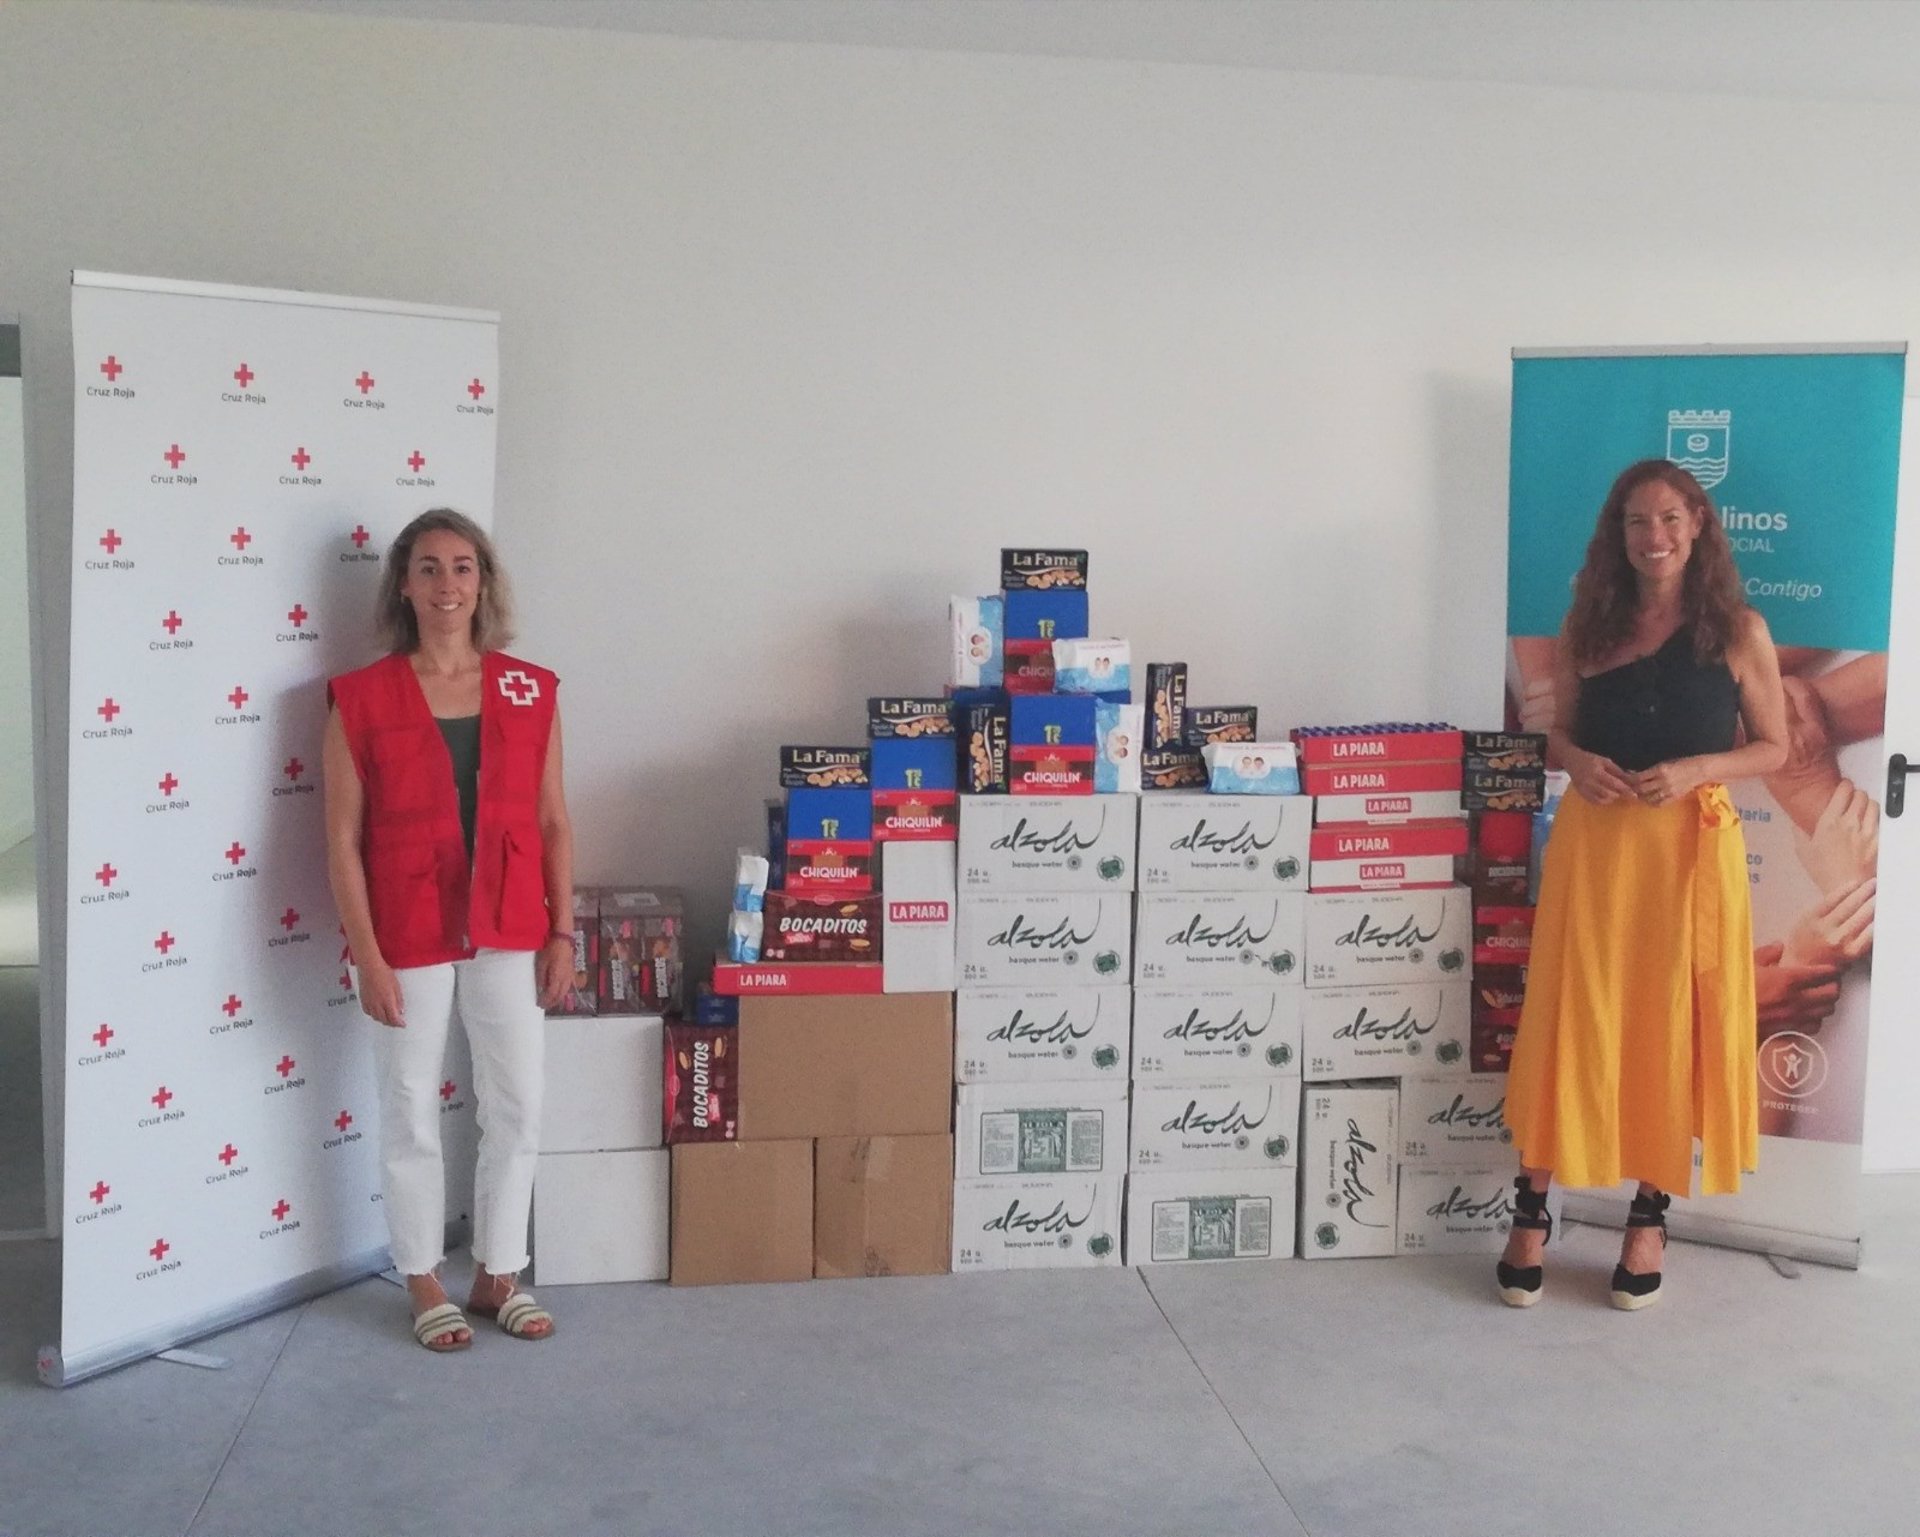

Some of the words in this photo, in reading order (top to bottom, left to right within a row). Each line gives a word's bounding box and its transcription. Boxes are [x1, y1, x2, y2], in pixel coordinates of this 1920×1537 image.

[86, 386, 110, 396] Cruz
[113, 387, 135, 399] Roja
[221, 392, 242, 402] Cruz
[244, 393, 266, 404] Roja
[343, 398, 363, 408] Cruz
[364, 399, 385, 410] Roja
[455, 404, 475, 413] Cruz
[476, 405, 494, 416] Roja
[150, 474, 173, 483] Cruz
[176, 474, 197, 485] Roja
[278, 475, 299, 484] Cruz
[301, 475, 321, 486] Roja
[395, 477, 415, 486] Cruz
[416, 477, 435, 487] Roja
[1721, 506, 1788, 531] linos
[1727, 537, 1775, 553] OCIAL
[217, 555, 239, 565] Cruz
[241, 555, 263, 566] Roja
[339, 551, 359, 562] Cruz
[360, 551, 379, 562] Roja
[1013, 552, 1032, 566] La
[1035, 553, 1078, 566] Fama
[84, 560, 109, 569] Cruz
[112, 559, 134, 570] Roja
[1745, 577, 1822, 601] Contigo
[275, 633, 296, 642] Cruz
[298, 632, 318, 641] Roja
[149, 641, 171, 650] Cruz
[173, 639, 193, 649] Roja
[881, 701, 900, 714] La
[903, 701, 947, 714] Fama
[214, 716, 236, 724] Cruz
[239, 714, 260, 723] Roja
[1196, 711, 1212, 724] La
[1213, 711, 1249, 724] Fama
[82, 729, 107, 738] Cruz
[110, 726, 132, 737] Roja
[994, 716, 1006, 735] La
[1475, 735, 1493, 748] La
[1495, 735, 1537, 748] Fama
[1333, 743, 1349, 756] LA
[1351, 742, 1385, 756] PIARA
[793, 750, 812, 763] La
[816, 750, 860, 764] Fama
[994, 738, 1006, 783] Fama
[1023, 771, 1081, 784] CHIQUILIN
[1334, 775, 1349, 789] LA
[1351, 774, 1385, 788] PIARA
[1475, 774, 1493, 787] La
[1495, 774, 1536, 788] Fama
[272, 785, 291, 796] Cruz
[293, 783, 314, 794] Roja
[145, 804, 166, 813] Cruz
[168, 800, 189, 809] Roja
[1368, 801, 1381, 812] LA
[1382, 799, 1409, 811] PIARA
[885, 816, 943, 828] CHIQUILIN
[990, 804, 1105, 854] alzola
[1170, 804, 1283, 854] alzola
[1338, 839, 1352, 852] LA
[1354, 837, 1390, 851] PIARA
[211, 871, 234, 881] Cruz
[236, 867, 256, 877] Roja
[800, 866, 858, 878] CHIQUILIN
[1361, 866, 1374, 878] LA
[1375, 865, 1403, 877] PIARA
[79, 894, 104, 904] Cruz
[107, 890, 129, 900] Roja
[893, 906, 908, 919] LA
[910, 905, 945, 918] PIARA
[780, 917, 867, 934] BOCADITOS
[987, 900, 1101, 949] alzola
[1166, 899, 1278, 948] alzola
[1335, 896, 1446, 947] alzola
[267, 935, 288, 947] Cruz
[290, 932, 310, 943] Roja
[141, 961, 162, 972] Cruz
[165, 956, 187, 967] Roja
[740, 973, 754, 986] LA
[755, 973, 787, 986] PIARA
[987, 994, 1100, 1044] alzola
[1163, 993, 1275, 1042] alzola
[1333, 990, 1442, 1040] alzola
[209, 1024, 230, 1034] Cruz
[232, 1019, 253, 1029] Roja
[77, 1054, 102, 1066] Cruz
[104, 1048, 125, 1059] Roja
[263, 1084, 284, 1094] Cruz
[286, 1078, 305, 1088] Roja
[693, 1041, 709, 1129] BOCADITOS
[1161, 1085, 1272, 1134] alzola
[137, 1116, 160, 1127] Cruz
[163, 1110, 185, 1121] Roja
[322, 1137, 342, 1149] Cruz
[343, 1131, 362, 1143] Roja
[205, 1172, 226, 1184] Cruz
[228, 1166, 248, 1177] Roja
[75, 1211, 98, 1224] Cruz
[100, 1203, 121, 1215] Roja
[983, 1183, 1097, 1233] alzola
[259, 1227, 279, 1239] Cruz
[281, 1221, 300, 1232] Roja
[135, 1268, 157, 1280] Cruz
[160, 1261, 181, 1272] Roja
